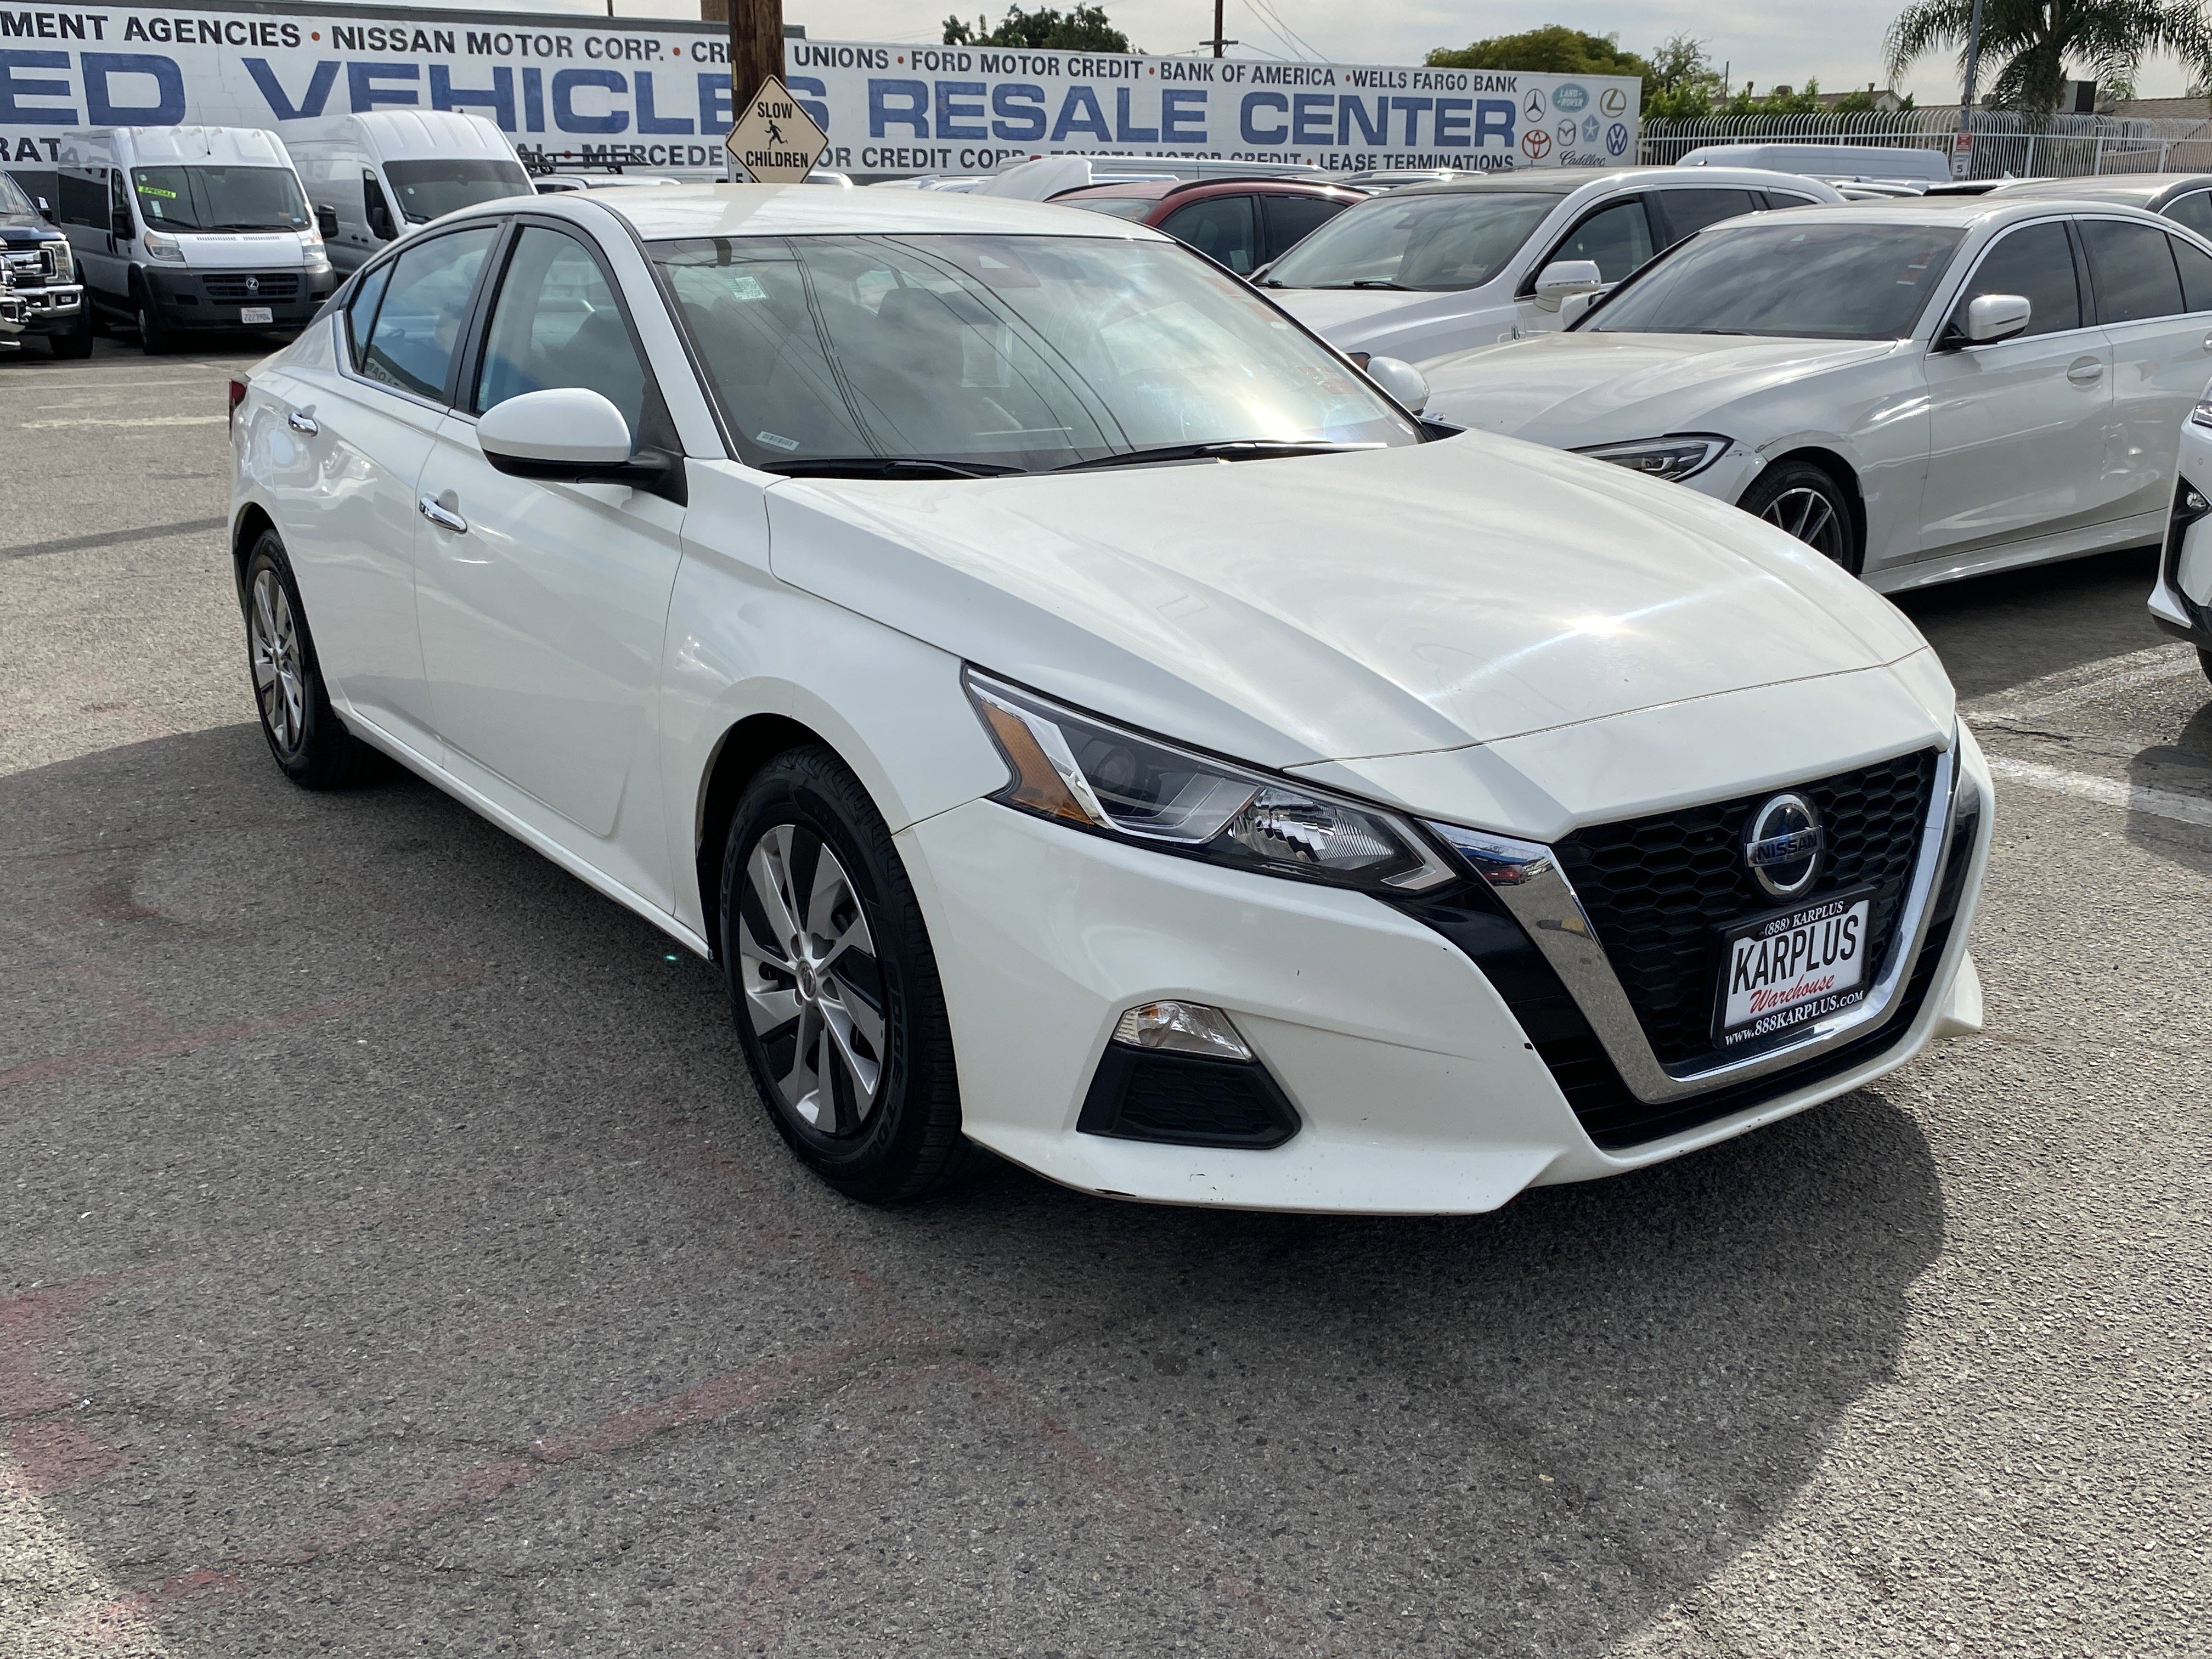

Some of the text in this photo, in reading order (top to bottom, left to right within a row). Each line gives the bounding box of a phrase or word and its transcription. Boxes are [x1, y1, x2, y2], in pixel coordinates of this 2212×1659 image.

[124, 16, 302, 48] AGENCIES
[332, 26, 455, 54] NISSAN
[467, 31, 573, 58] MOTOR
[584, 37, 664, 61] CORP.
[794, 46, 889, 70] UNIONS
[911, 51, 1143, 80] FORD MOTOR CREDIT
[1160, 62, 1335, 88] BANK OF AMERICA
[1352, 70, 1518, 93] WELLS FARGO BANK
[758, 101, 792, 119] SLOW
[867, 78, 1207, 144] RESALE
[1240, 91, 1516, 148] CENTER
[582, 144, 723, 166] MERCEDE
[746, 151, 808, 167] CHILDREN
[862, 148, 952, 168] CREDIT
[1320, 153, 1514, 172] LEASE TERMINATIONS
[1957, 165, 1963, 173] 5
[1757, 834, 1818, 860] NISSAN
[1764, 901, 1844, 936] (888) KARPLUS
[1732, 915, 1859, 995] KARPLUS
[1750, 974, 1835, 1014] Warehouse
